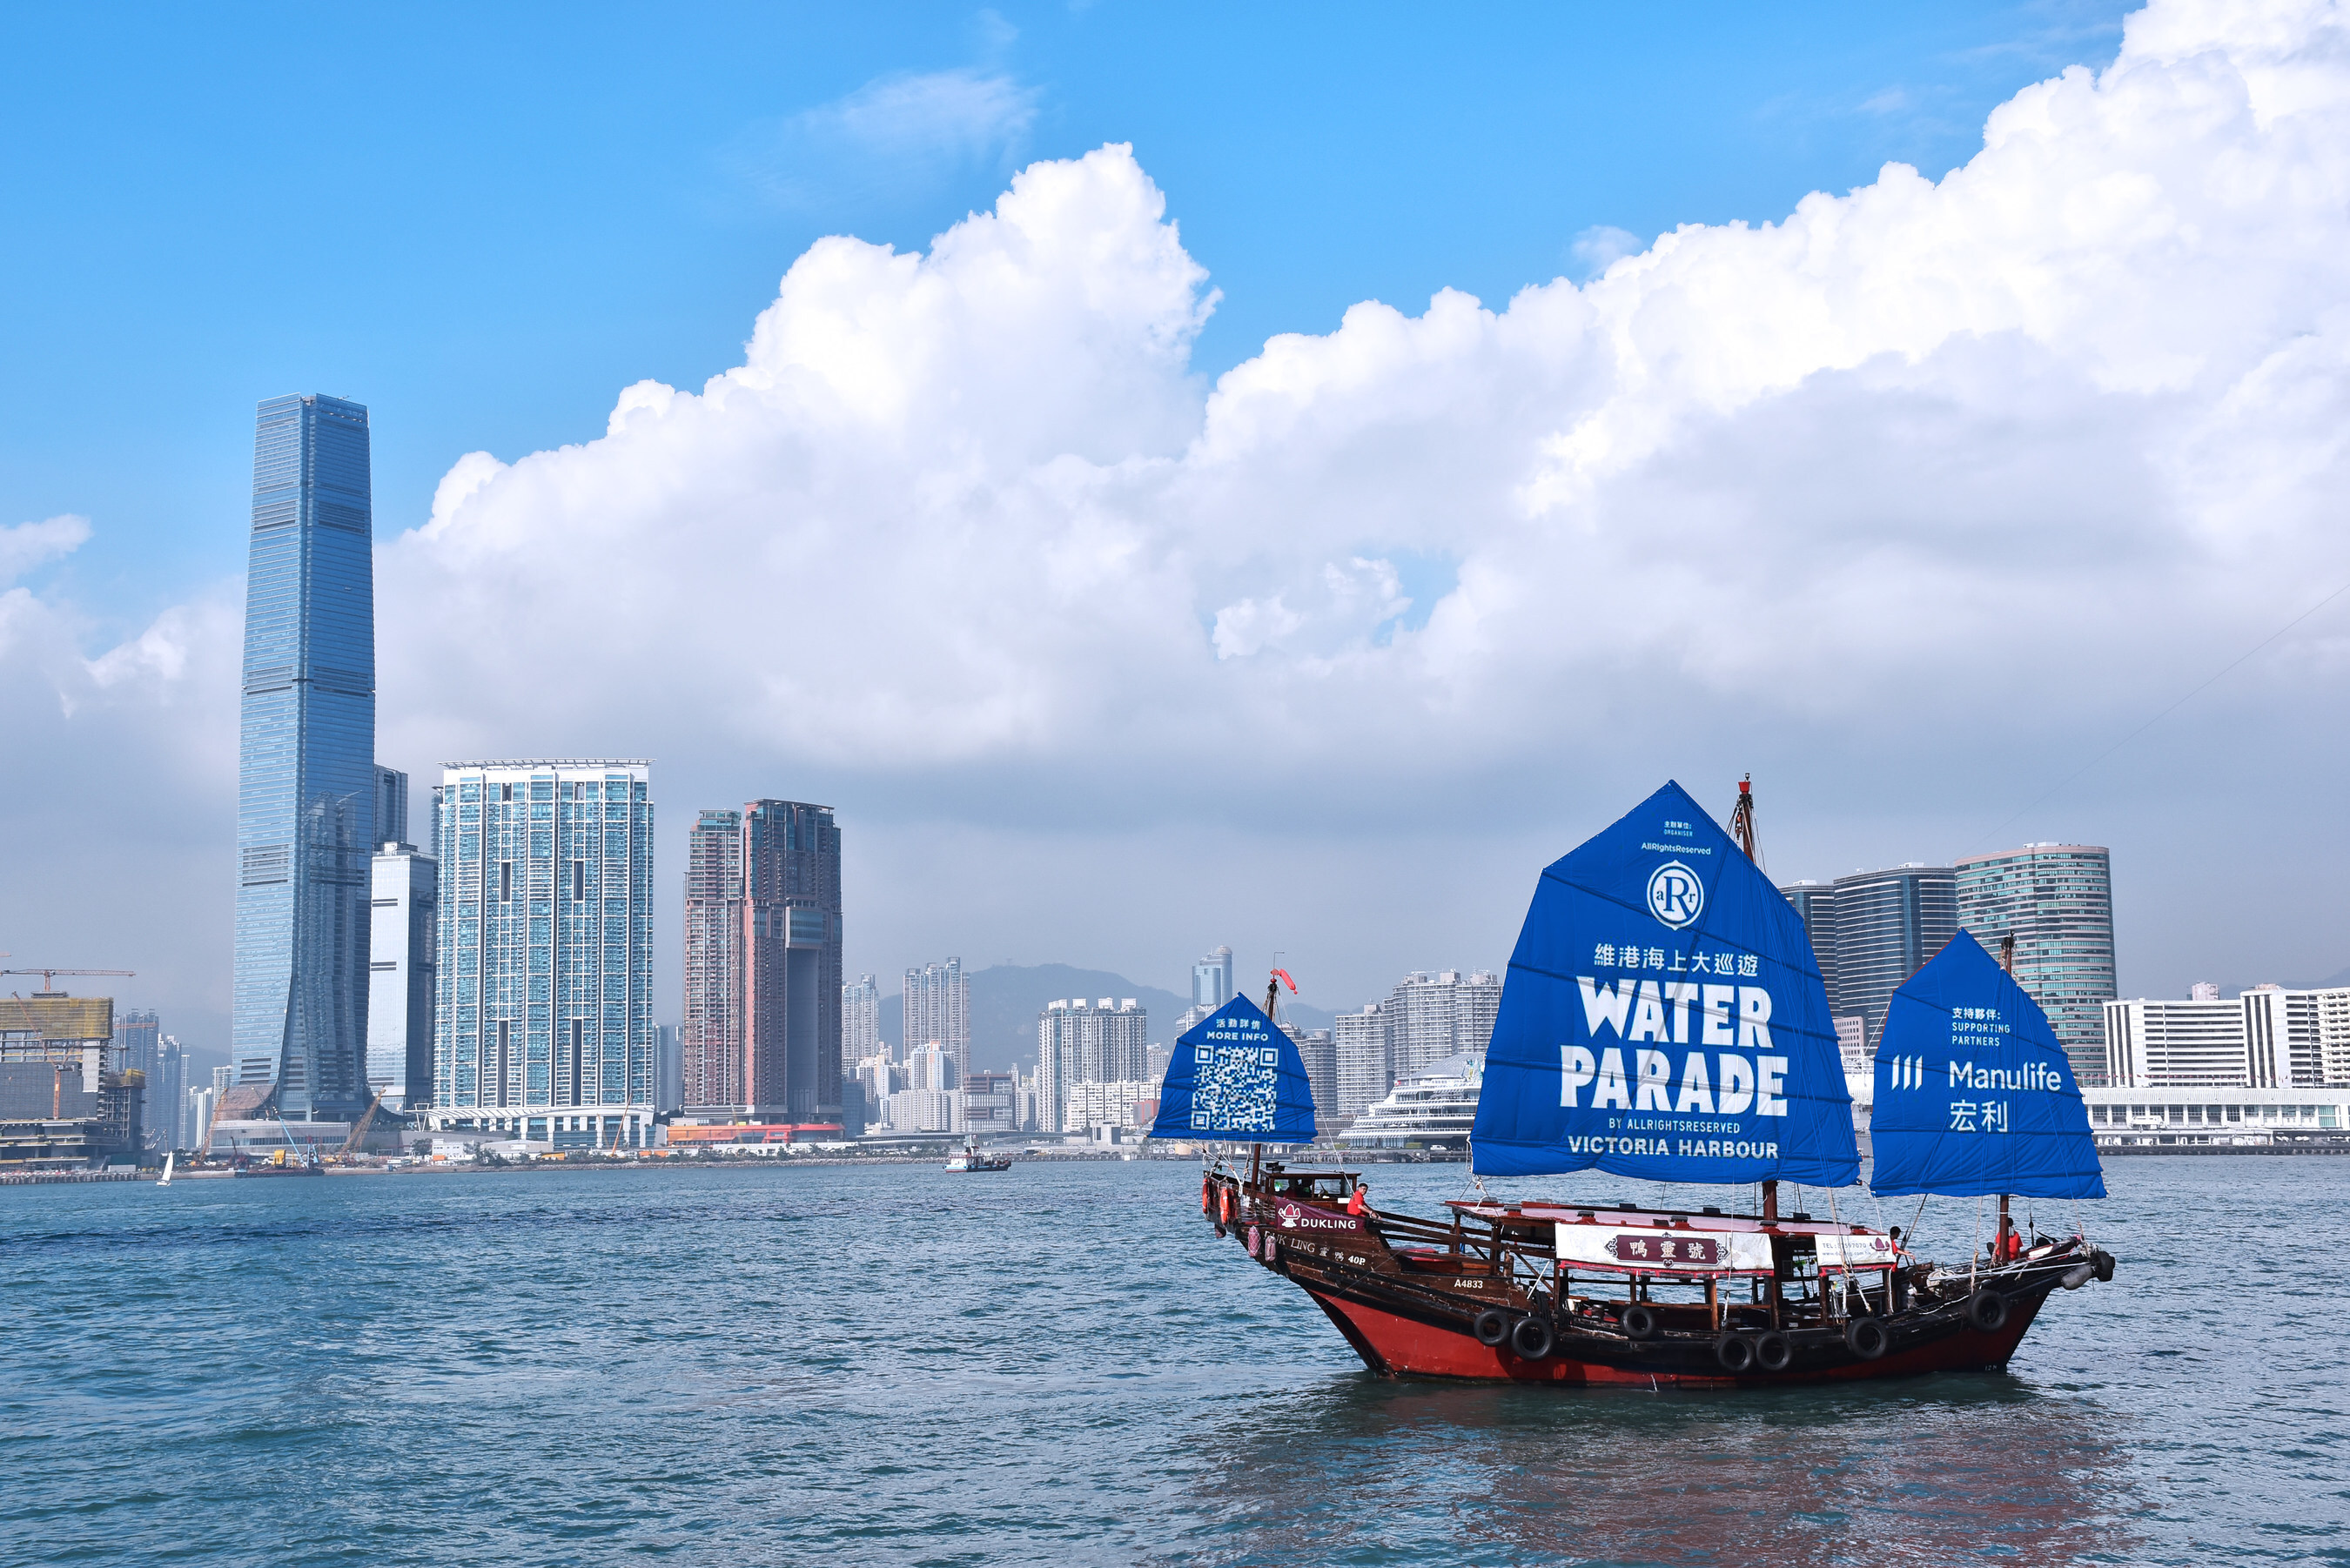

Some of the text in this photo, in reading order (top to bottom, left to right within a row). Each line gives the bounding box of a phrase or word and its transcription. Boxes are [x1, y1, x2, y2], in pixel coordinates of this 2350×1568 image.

[1663, 828, 1693, 837] ORGANISER
[1641, 842, 1711, 855] AllRightsReserved
[1594, 942, 1758, 977] 維港海上大巡遊
[1576, 975, 1774, 1049] WATER
[1216, 1017, 1261, 1031] 活動詳情
[1951, 1022, 2011, 1034] SUPPORTING
[1206, 1031, 1269, 1042] MORE INFO
[1951, 1035, 2000, 1047] PARTNERS
[1560, 1045, 1789, 1116] PARADE
[1949, 1060, 2062, 1092] Manulife
[1950, 1099, 2008, 1133] 宏利
[1608, 1117, 1740, 1134] BY ALLRIGHTSRESERVED
[1568, 1135, 1779, 1160] VICTORIA HARBOUR
[1300, 1218, 1357, 1230] DUKLING
[1291, 1237, 1315, 1253] LING
[1629, 1239, 1706, 1260] 鴨靈號
[1454, 1278, 1484, 1289] A4833
